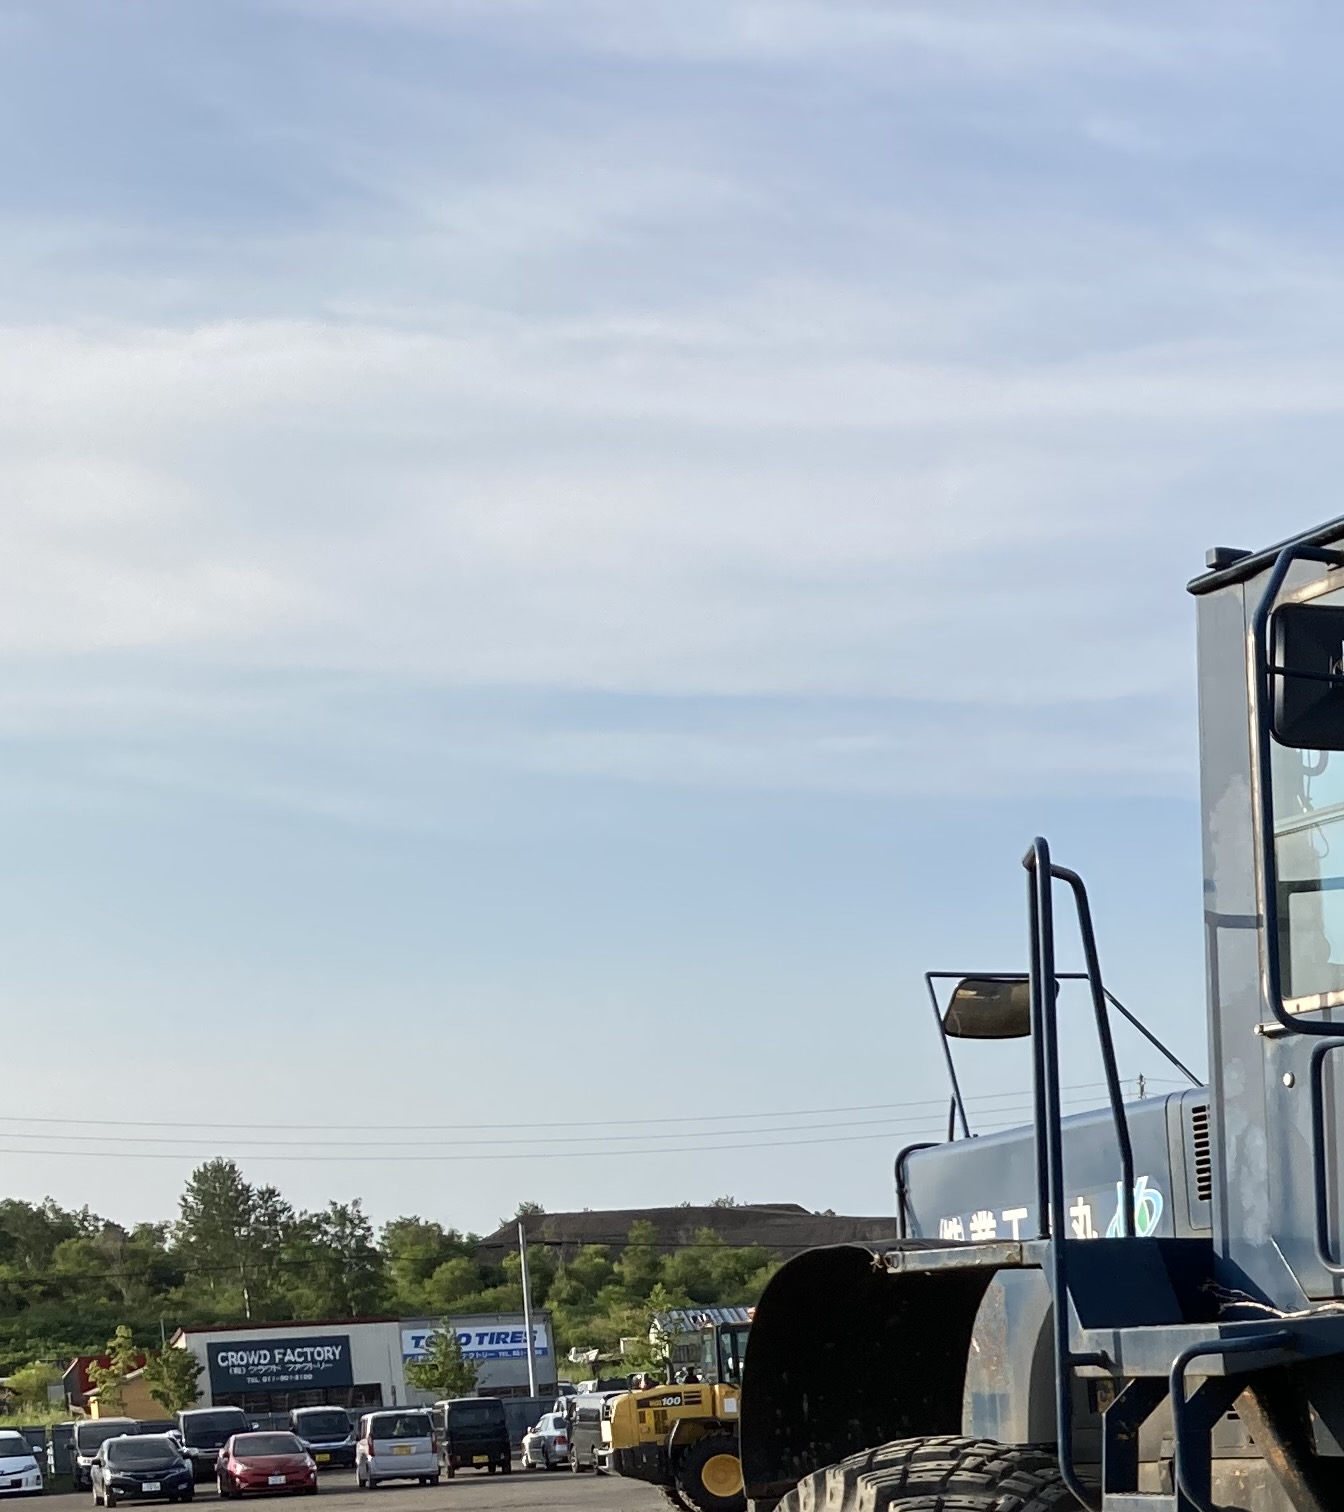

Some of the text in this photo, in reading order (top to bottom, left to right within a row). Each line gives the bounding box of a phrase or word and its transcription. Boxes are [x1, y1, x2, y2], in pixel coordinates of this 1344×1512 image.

[411, 1333, 472, 1348] TOO
[217, 1345, 342, 1367] CROWD FACTORY
